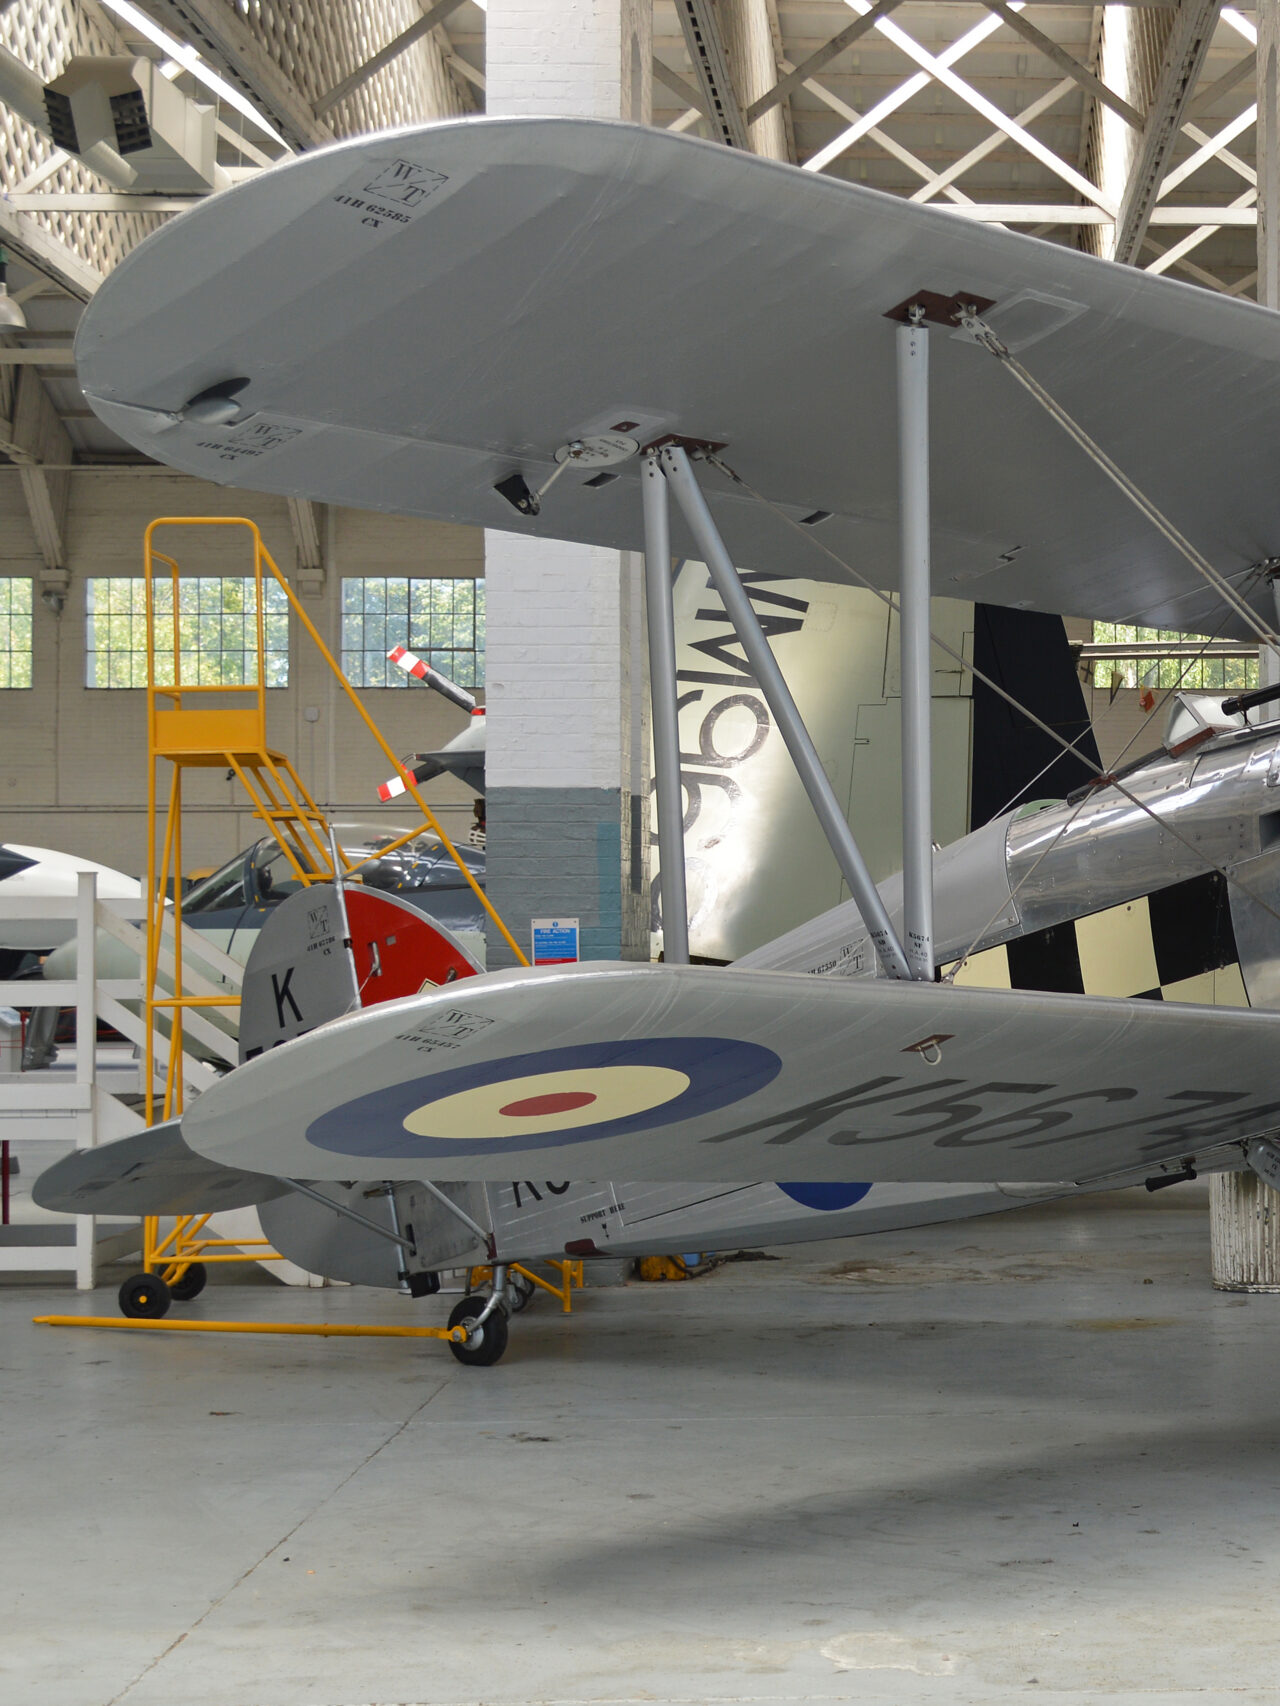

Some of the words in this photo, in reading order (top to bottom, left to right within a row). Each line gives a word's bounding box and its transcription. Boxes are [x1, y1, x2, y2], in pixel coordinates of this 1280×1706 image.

[401, 185, 427, 202] T
[365, 203, 412, 224] 62585
[271, 967, 304, 1029] K
[453, 1026, 474, 1036] T
[580, 1209, 606, 1224] SUPPORT
[609, 1202, 626, 1214] HERE
